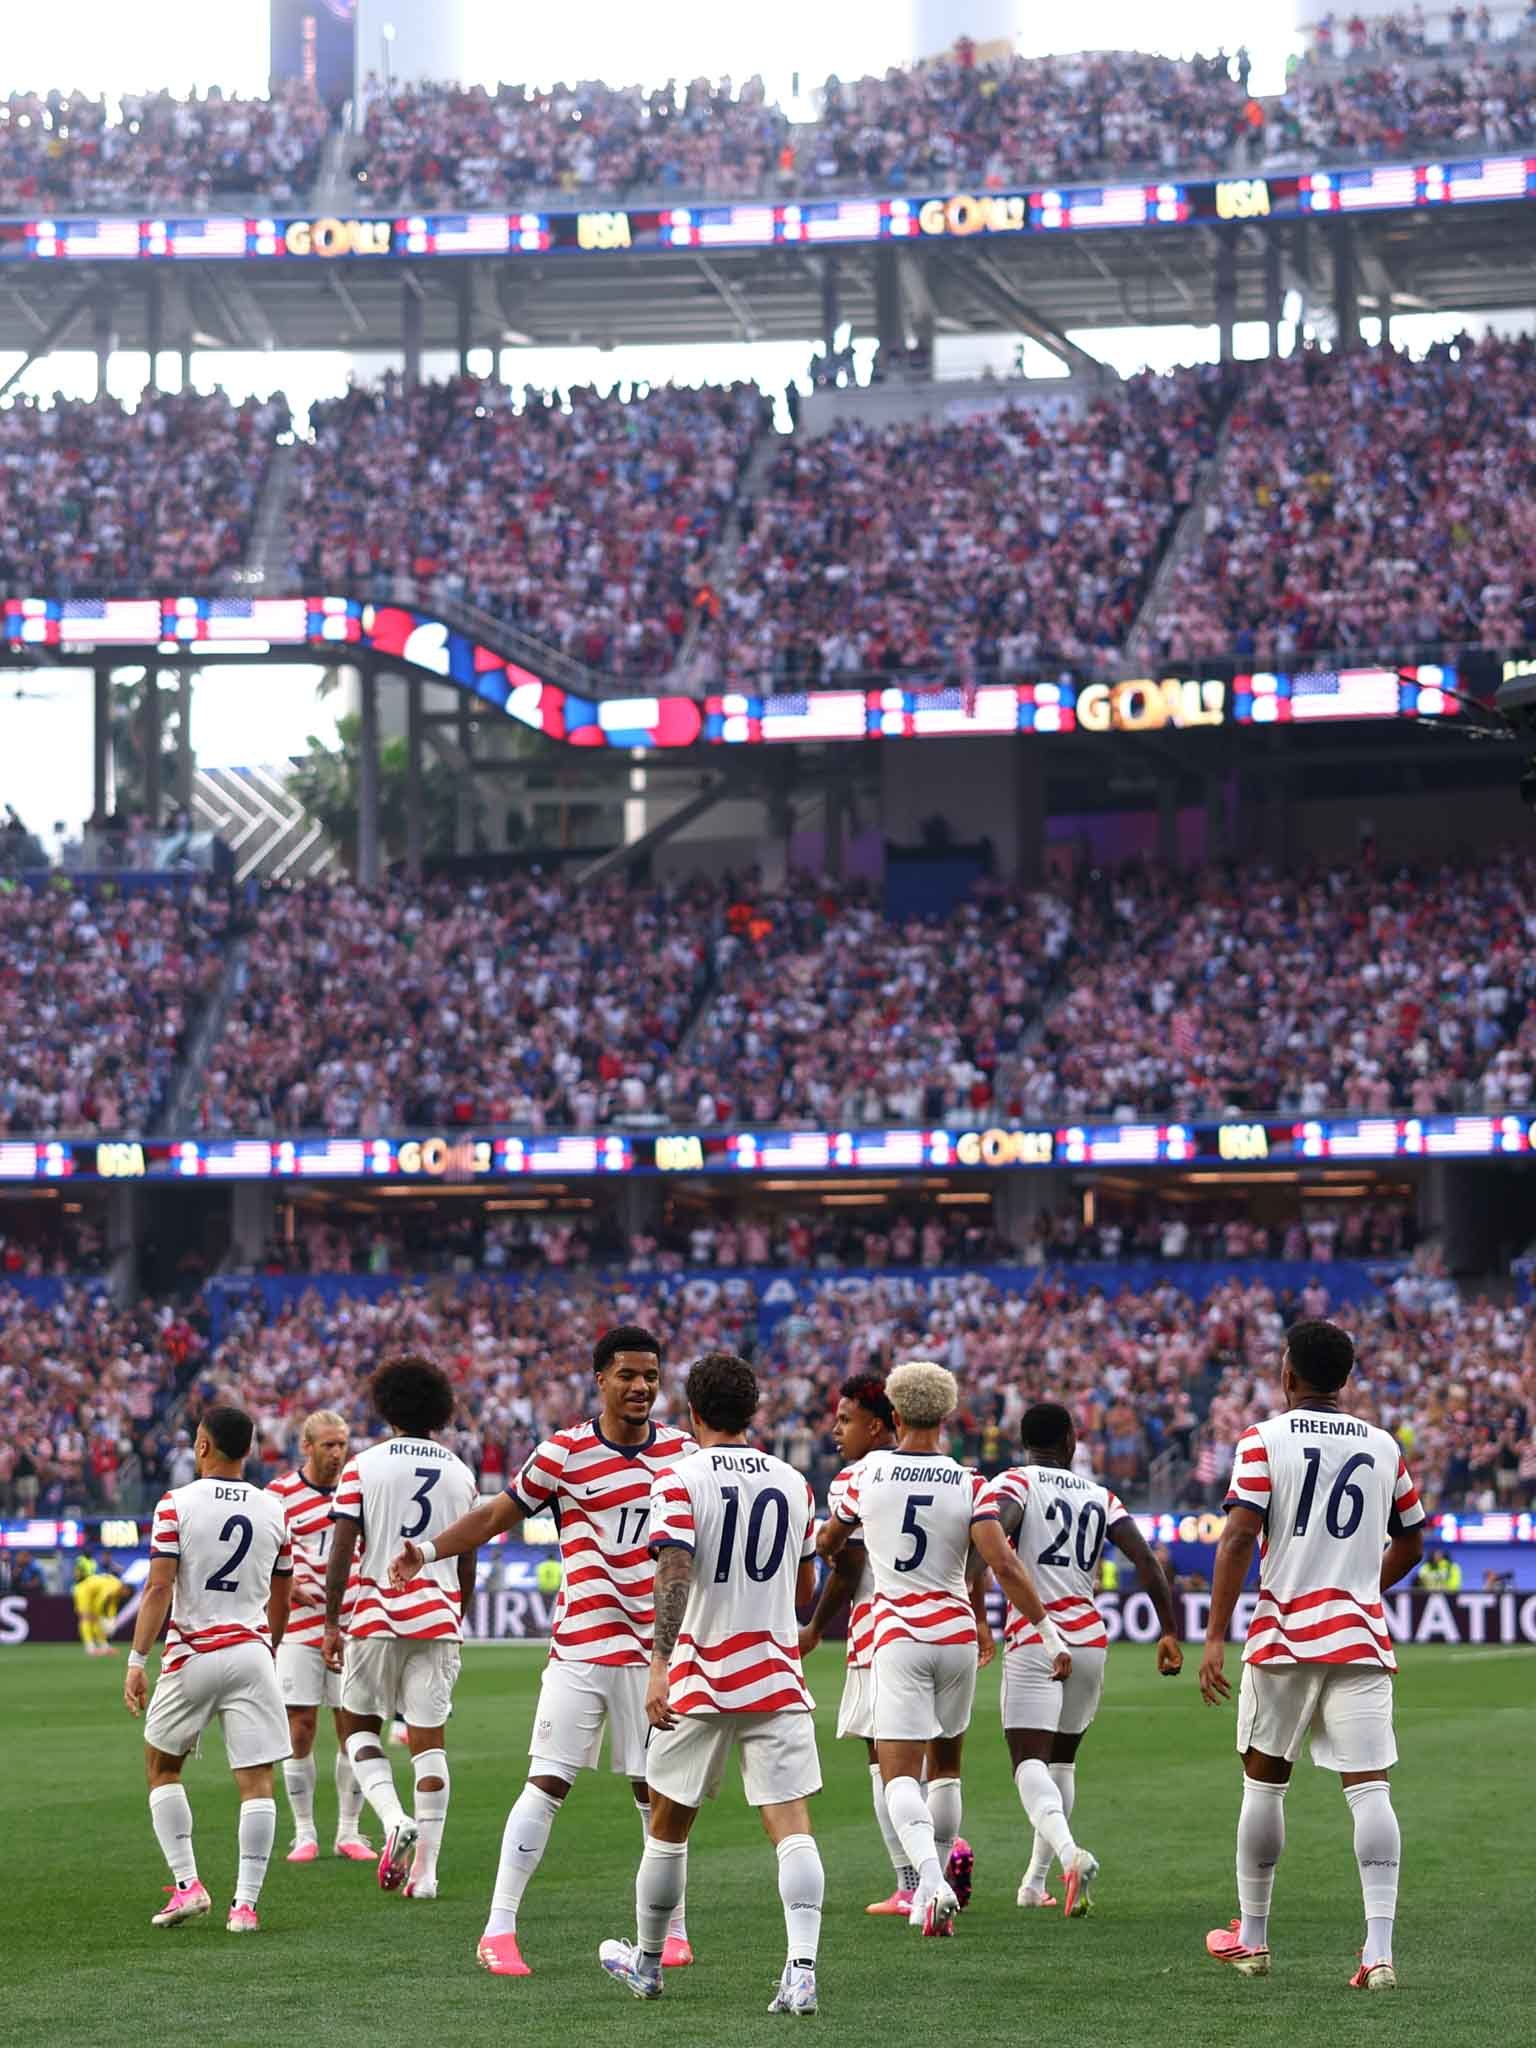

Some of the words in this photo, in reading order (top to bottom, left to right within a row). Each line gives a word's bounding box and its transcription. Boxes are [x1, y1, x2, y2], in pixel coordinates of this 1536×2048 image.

[1290, 1418, 1368, 1438] FREEMAN
[215, 1486, 249, 1502] DEST
[711, 1455, 770, 1474] PULISIC
[872, 1467, 884, 1485] A.
[890, 1466, 963, 1486] ROBINSON
[1293, 1447, 1375, 1539] 16
[400, 1467, 441, 1538] 3
[616, 1507, 650, 1545] 17
[713, 1485, 789, 1583] 10
[894, 1494, 935, 1573] 5
[1037, 1497, 1107, 1573] 20
[204, 1514, 254, 1593] 2
